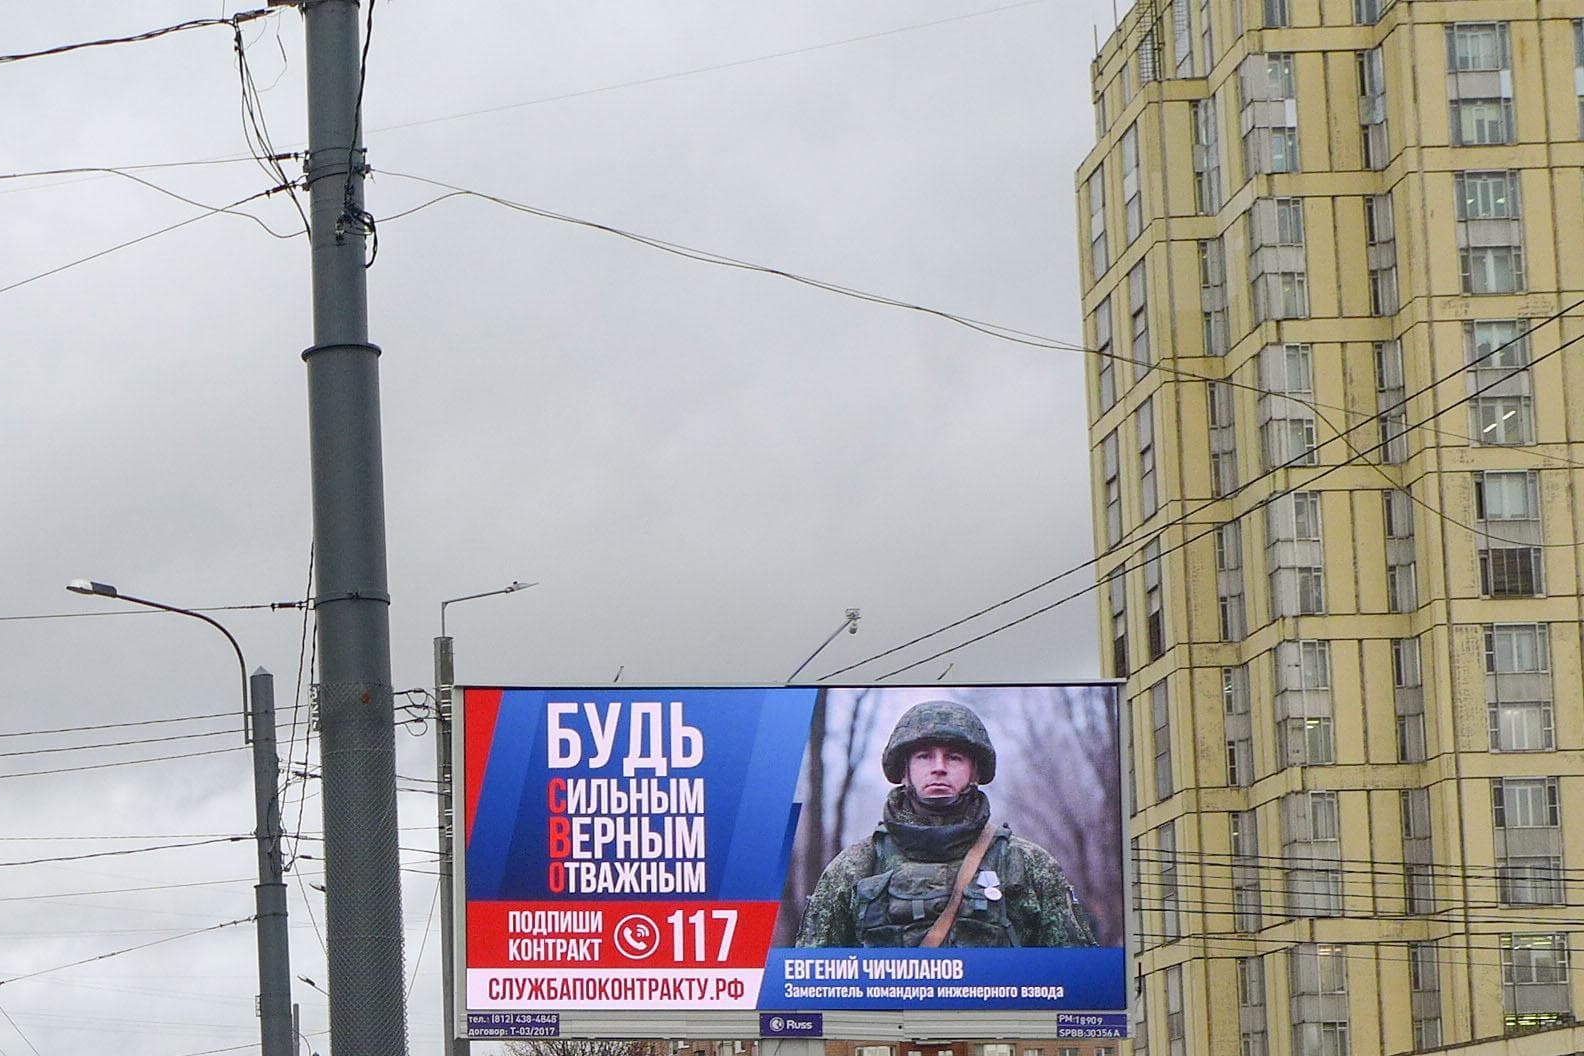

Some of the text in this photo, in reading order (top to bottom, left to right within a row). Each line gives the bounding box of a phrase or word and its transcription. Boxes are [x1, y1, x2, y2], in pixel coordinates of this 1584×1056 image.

[547, 701, 704, 777] БУДЬ
[548, 777, 705, 815] СИЛЬНЫМ
[548, 816, 706, 860] ВЕРНЫМ
[548, 861, 706, 894] ОТВАЖНЫМ
[508, 910, 603, 935] ПОДПИШИ
[667, 909, 738, 962] 117
[508, 938, 603, 961] КОНТРАКТ
[784, 955, 964, 980] ЕВГЕНИЙ ЧИЧИЛАНОВ
[488, 977, 745, 1001] СЛУЖБАПОКОНТРАКТУ.РФ
[784, 983, 1064, 1000] Заместитель командира инженерного взвода
[492, 1014, 514, 1024] (812)
[787, 1019, 813, 1030] Russ
